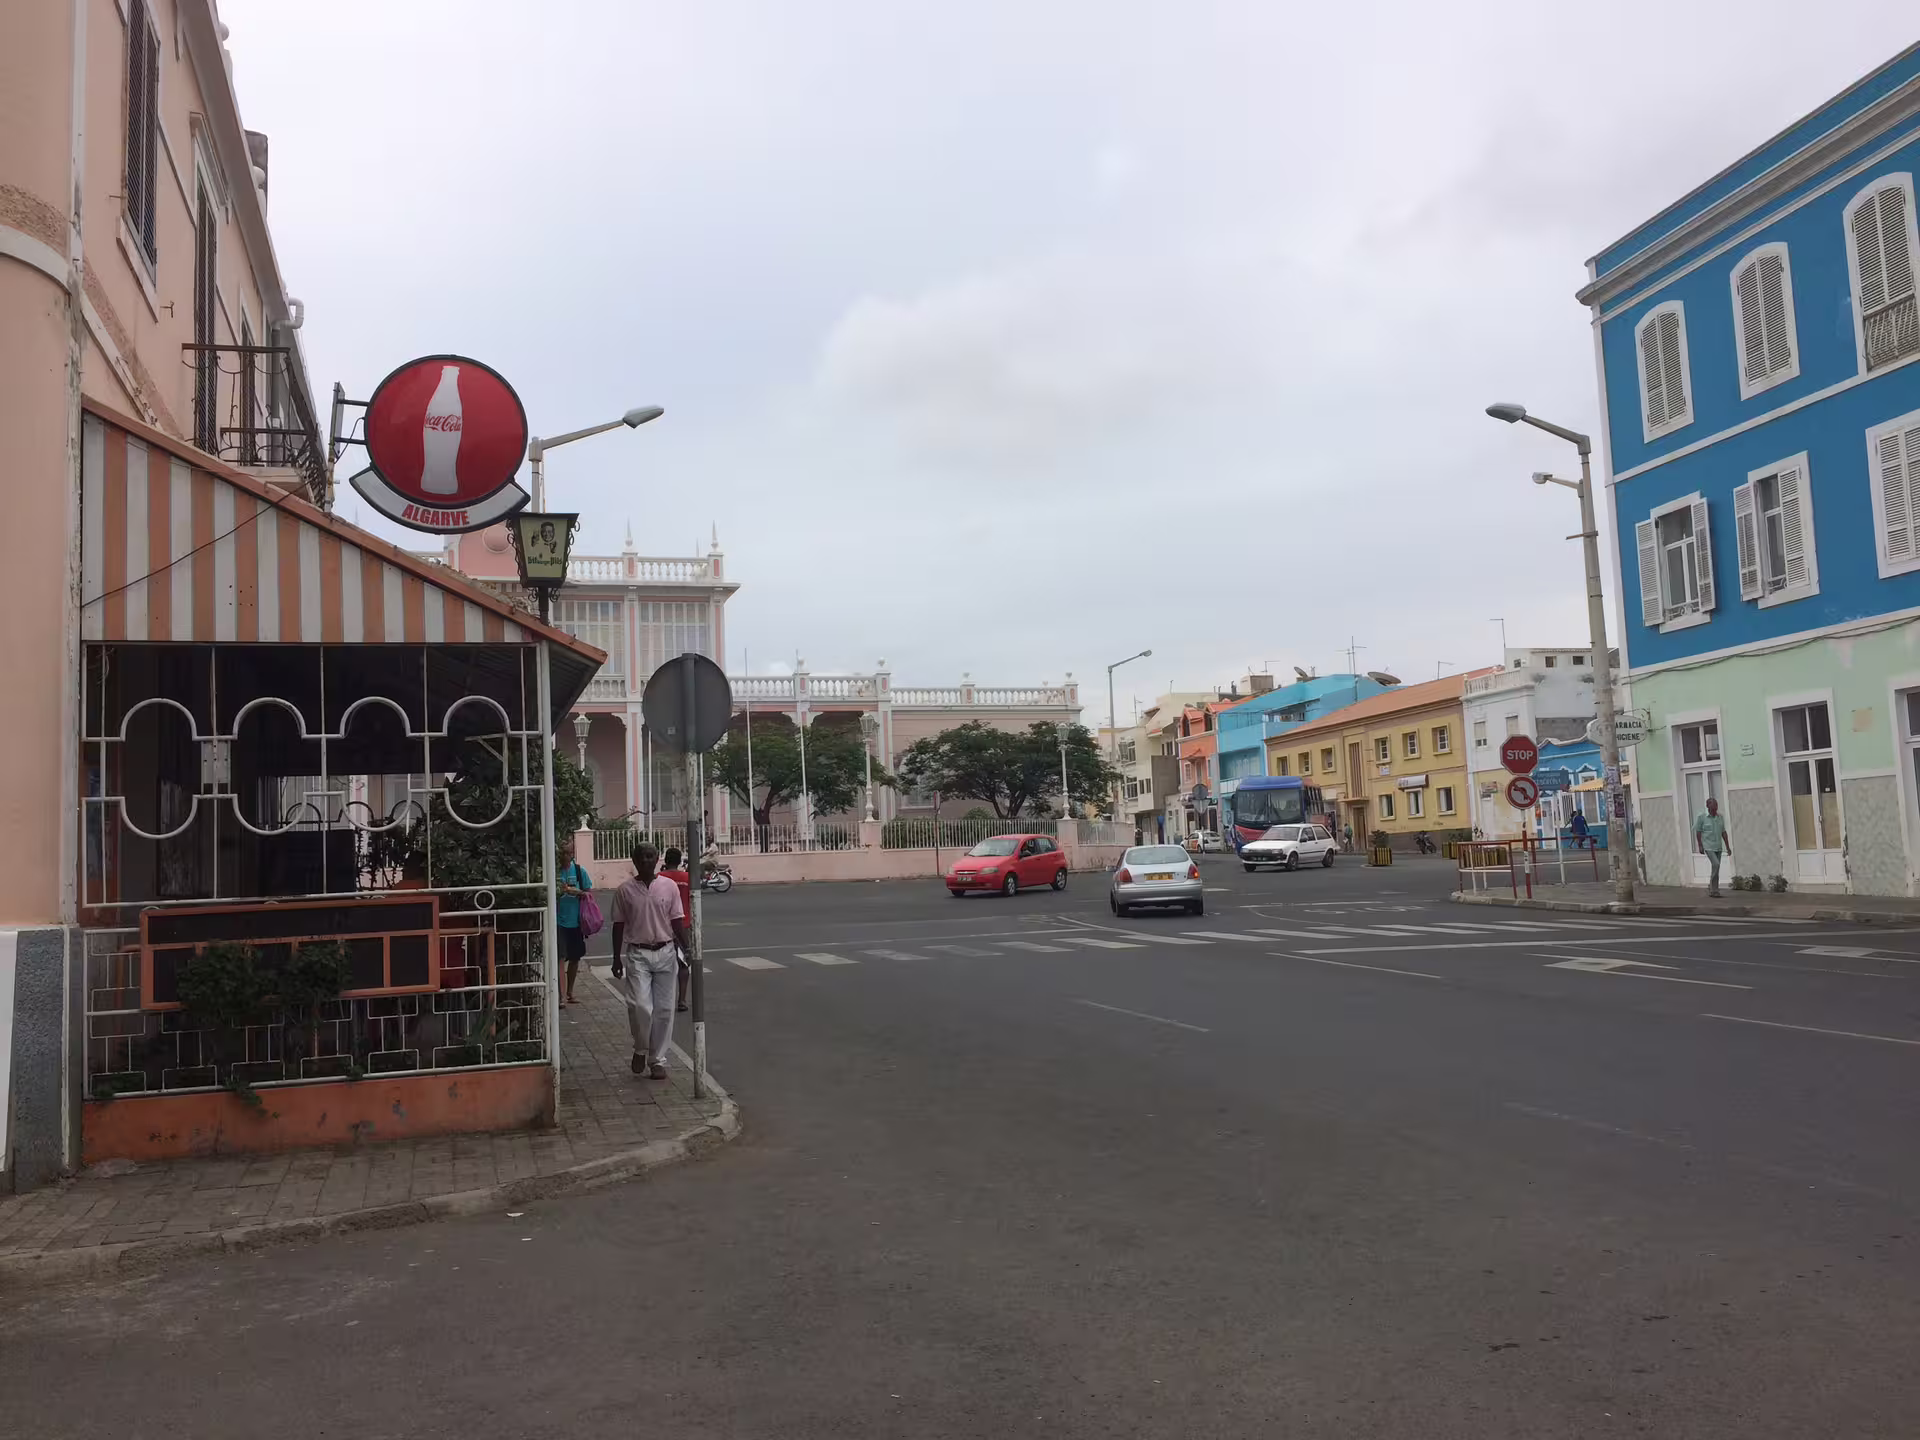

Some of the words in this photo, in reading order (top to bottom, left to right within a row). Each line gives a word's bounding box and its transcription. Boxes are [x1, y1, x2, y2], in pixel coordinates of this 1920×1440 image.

[425, 414, 462, 432] oca-Cola
[402, 504, 470, 526] ALGARVE
[1615, 721, 1643, 729] ARMACIA
[1507, 749, 1534, 761] STOP
